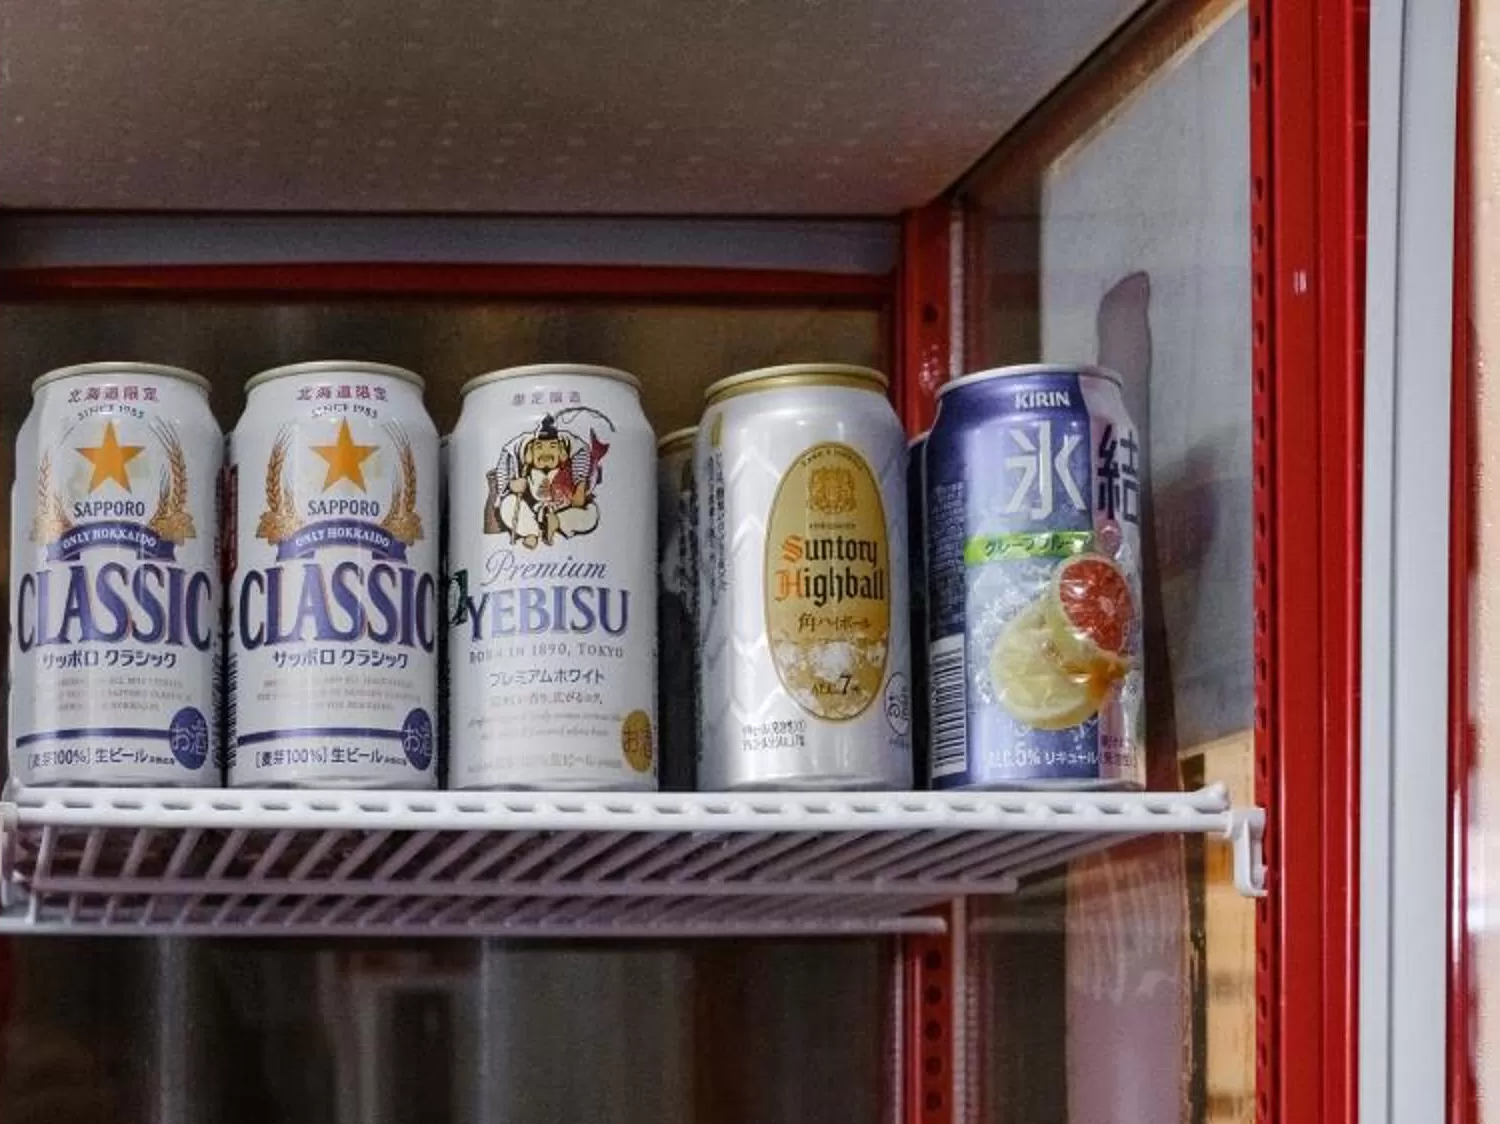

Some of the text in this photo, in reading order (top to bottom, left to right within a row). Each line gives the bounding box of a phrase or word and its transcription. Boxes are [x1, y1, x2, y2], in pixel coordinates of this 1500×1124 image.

[68, 386, 160, 403] 北海道限定
[295, 385, 388, 402] 北海道限定
[1015, 391, 1070, 409] KIRIN
[1004, 419, 1140, 521] 氷結
[73, 500, 146, 518] SAPPORO
[307, 499, 381, 517] SAPPORO
[63, 527, 157, 549] ONLY HOKKAIDO
[327, 527, 390, 547] HOKKAIDO
[783, 535, 879, 568] Suntory
[479, 548, 609, 587] Premium
[774, 567, 885, 608] Highball
[17, 562, 213, 653] CLASSIC
[239, 562, 435, 654] CLASSIC
[467, 585, 631, 643] YEBISU
[42, 649, 177, 670] サッポロ クラシック
[272, 649, 409, 669] サッポロ クラシック
[577, 641, 624, 659] TOKYO
[488, 667, 606, 688] プレミアムホワイト
[95, 748, 149, 765] 生ビール
[331, 747, 383, 765] 生ビール
